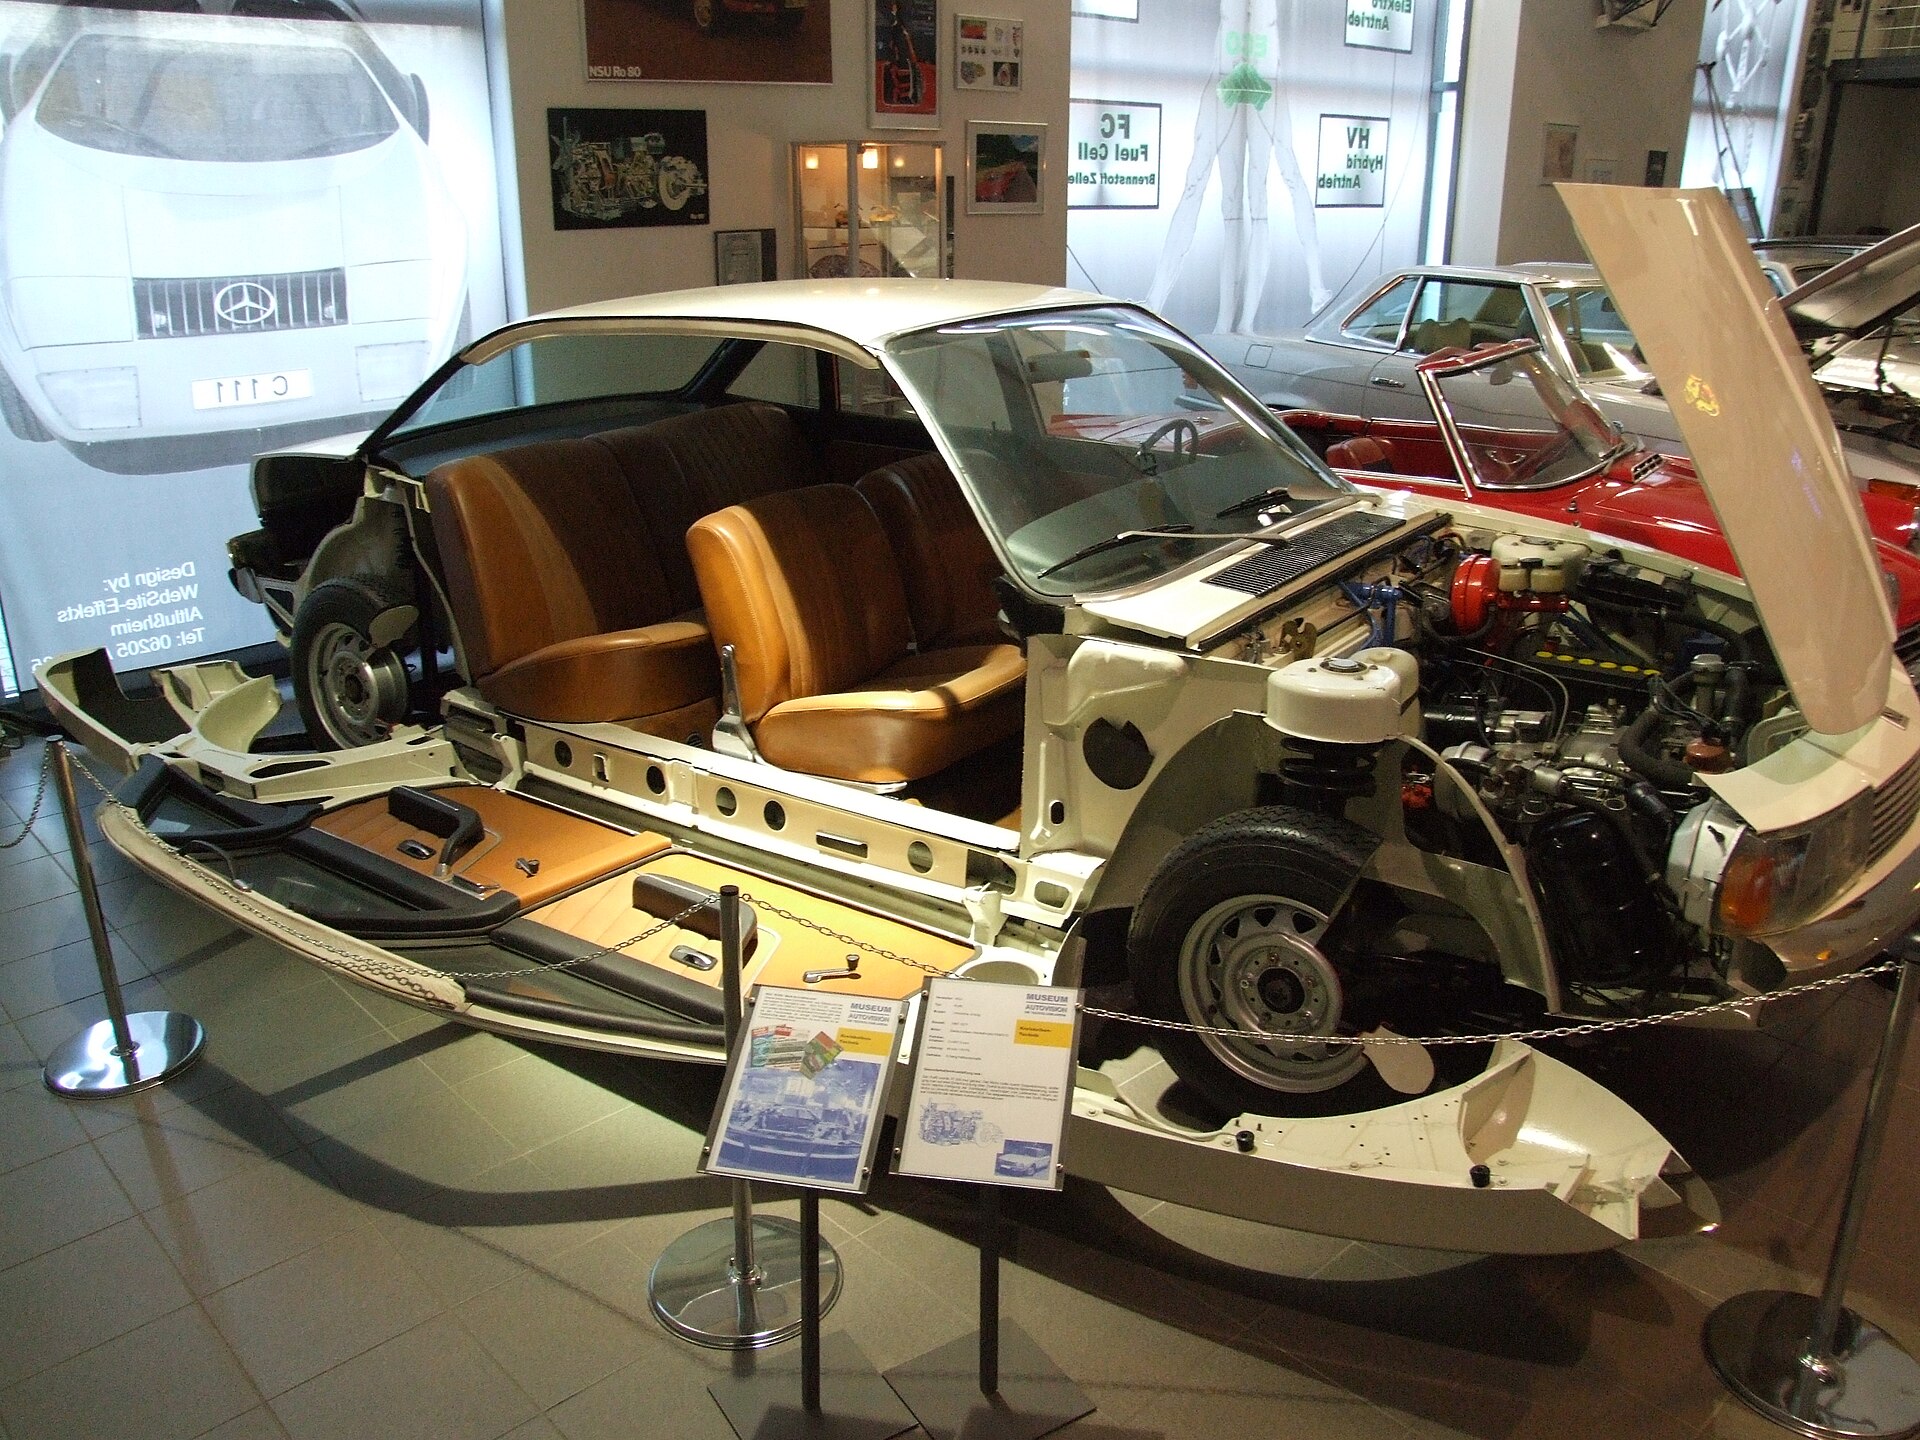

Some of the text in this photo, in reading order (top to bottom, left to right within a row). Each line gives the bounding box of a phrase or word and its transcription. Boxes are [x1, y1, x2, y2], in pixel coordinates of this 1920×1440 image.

[589, 65, 641, 77] NSU Ro 80
[1026, 993, 1068, 1003] MUSEUM
[850, 1003, 892, 1013] MUSEUM
[1025, 1004, 1067, 1013] AUTOVISION
[847, 1013, 890, 1022] AUTOVISION
